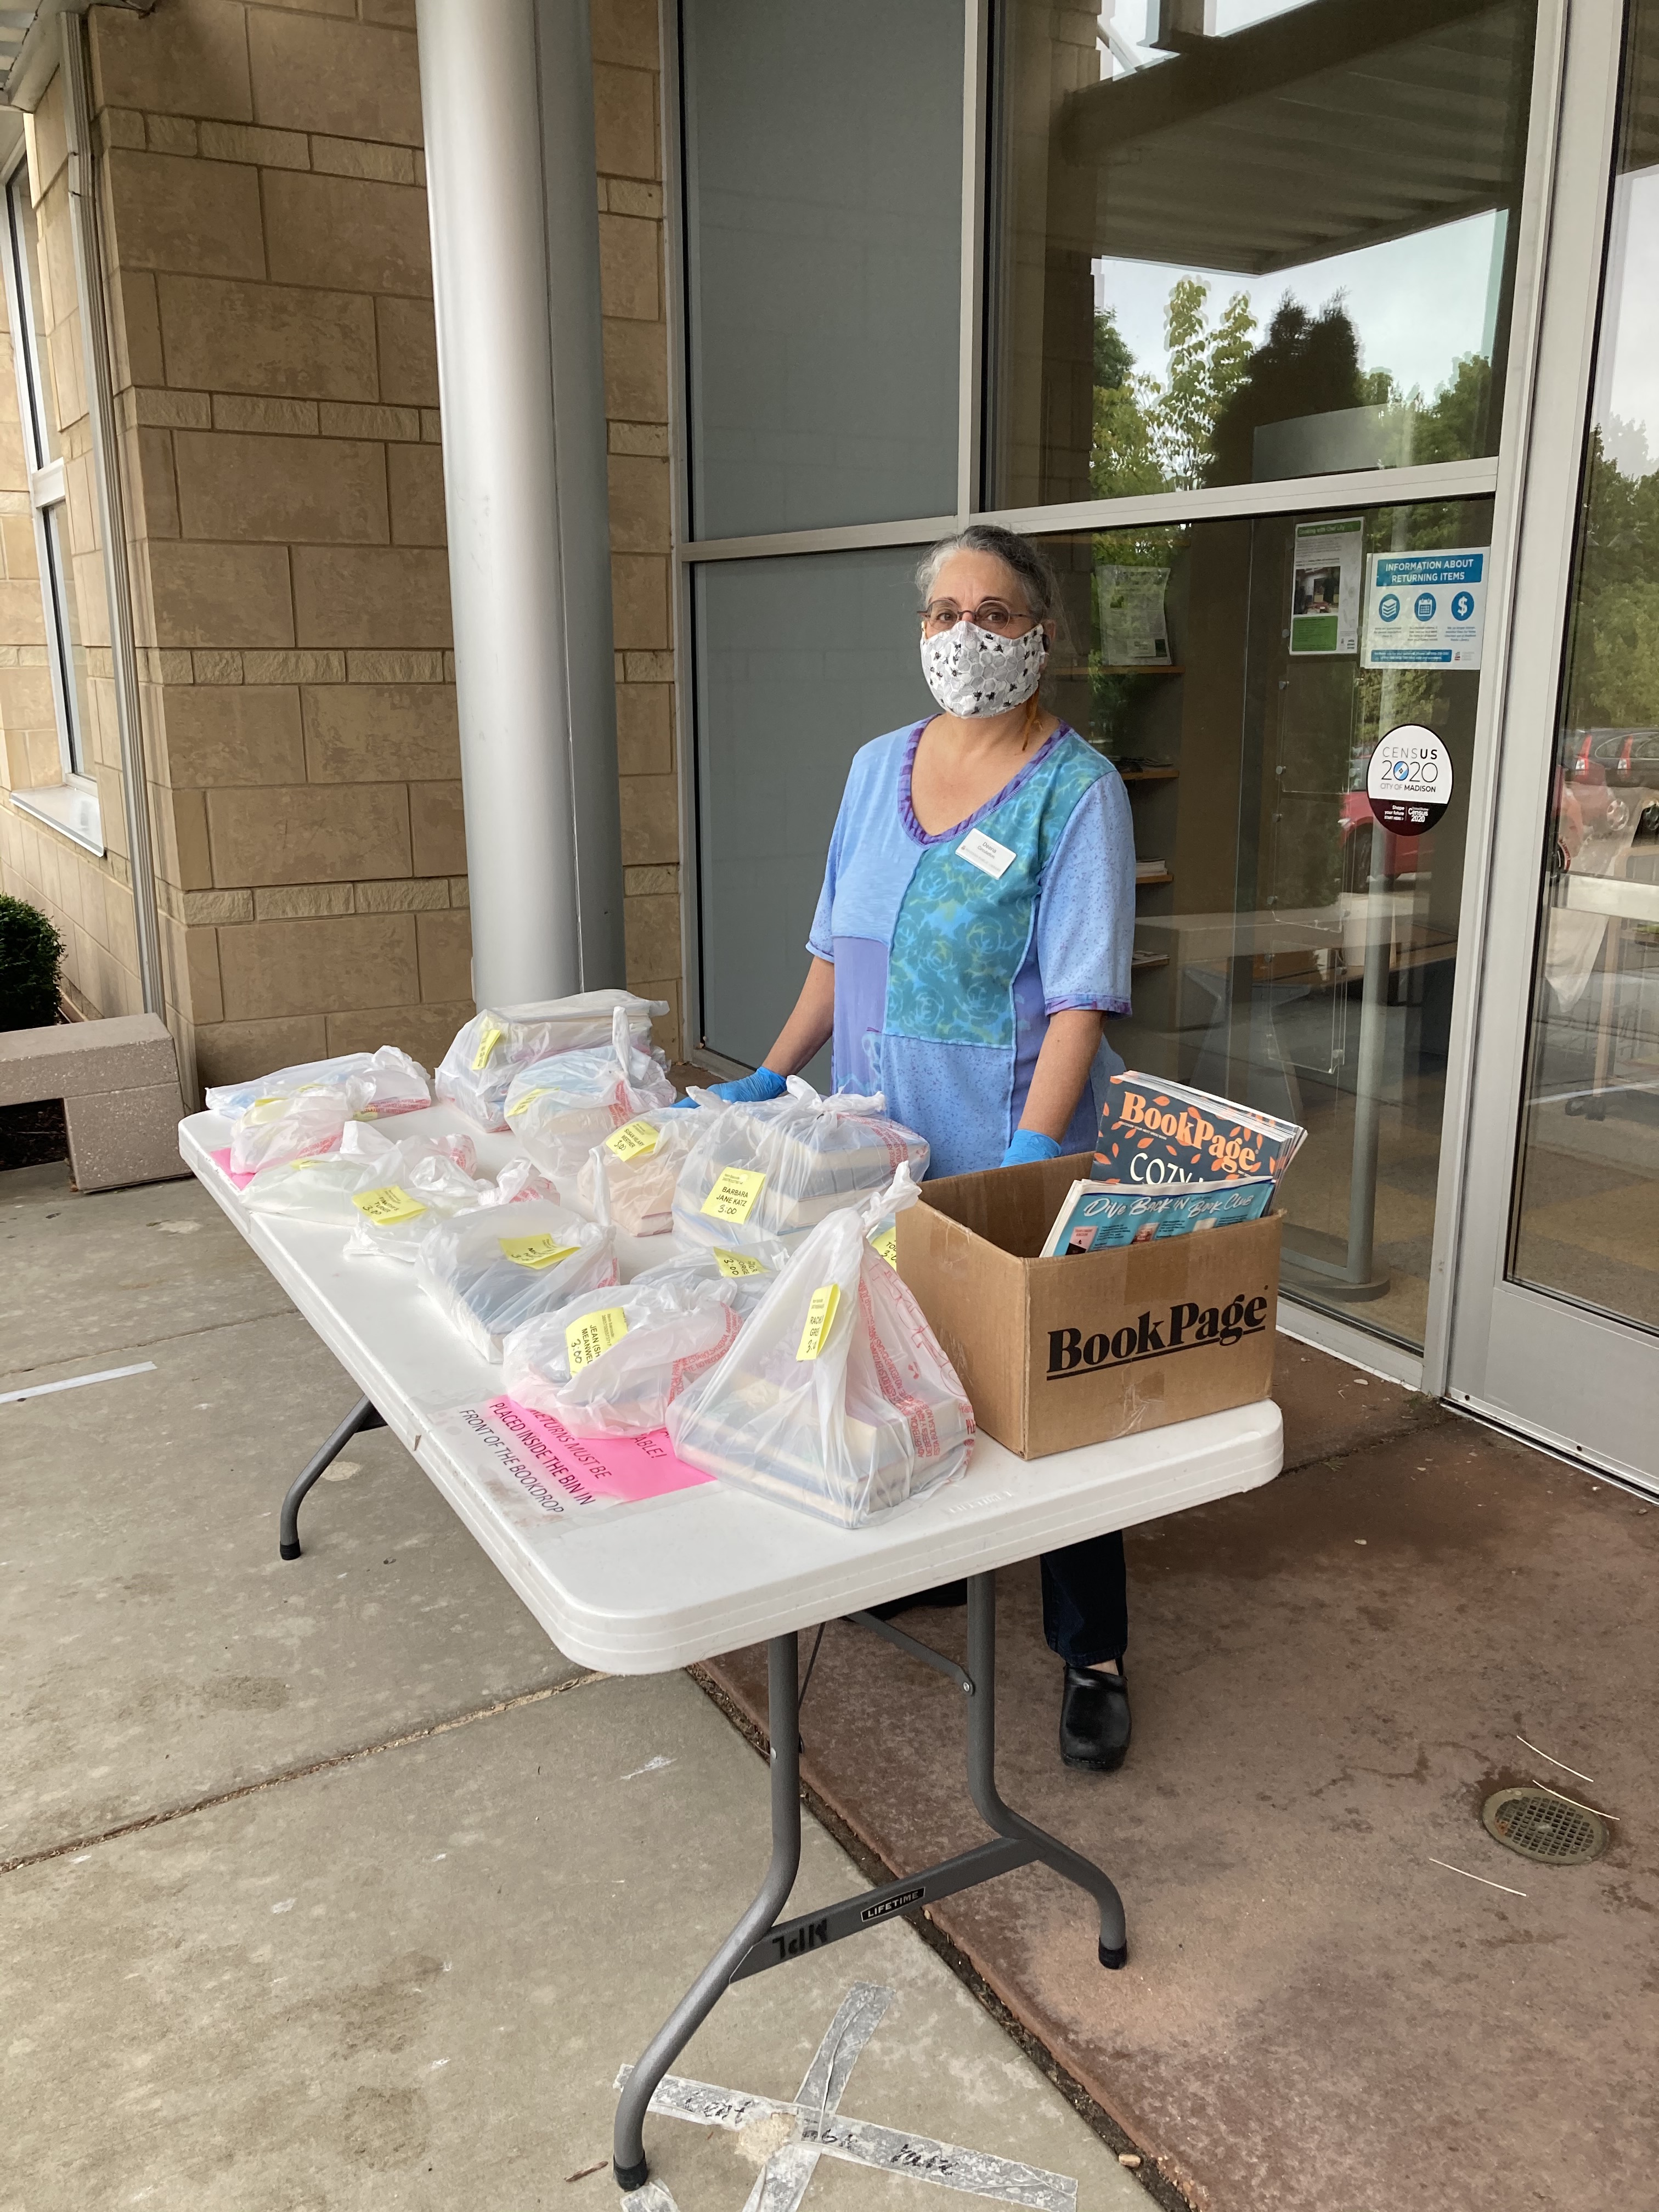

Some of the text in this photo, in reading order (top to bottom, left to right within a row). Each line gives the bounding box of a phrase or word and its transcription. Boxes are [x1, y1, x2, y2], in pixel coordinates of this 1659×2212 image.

[1386, 559, 1474, 572] INFORMATION ABOUT
[1391, 572, 1465, 583] RETURNING ITEMS
[1383, 747, 1437, 759] CENSUS
[1381, 760, 1438, 783] 2020
[1408, 808, 1429, 816] Census
[977, 845, 995, 859] Circulation
[1119, 1091, 1256, 1173] BookPage
[614, 1140, 627, 1150] 3:00
[716, 1194, 733, 1204] JANE
[722, 1187, 748, 1198] BARBARA
[718, 1204, 737, 1215] 3:00
[724, 1259, 739, 1275] 3:00
[737, 1259, 750, 1275] ORGE
[590, 1324, 601, 1357] JEAN (SH
[1047, 1294, 1267, 1373] BookPage
[571, 1339, 582, 1364] 3:00
[581, 1328, 593, 1364] MEANWEL
[806, 1339, 817, 1353] 3:0
[925, 1409, 934, 1418] NO
[928, 1419, 938, 1440] BOLSA
[489, 1402, 596, 1506] PLACED INSIDE THE BIN IN
[630, 1433, 668, 1459] ABLE!
[459, 1409, 565, 1514] FRONT OF THE BOOKDROP
[565, 1442, 600, 1468] MUST
[589, 1465, 612, 1480] BE
[868, 1891, 918, 1918] LIFETIME
[772, 1917, 827, 1959] MPL
